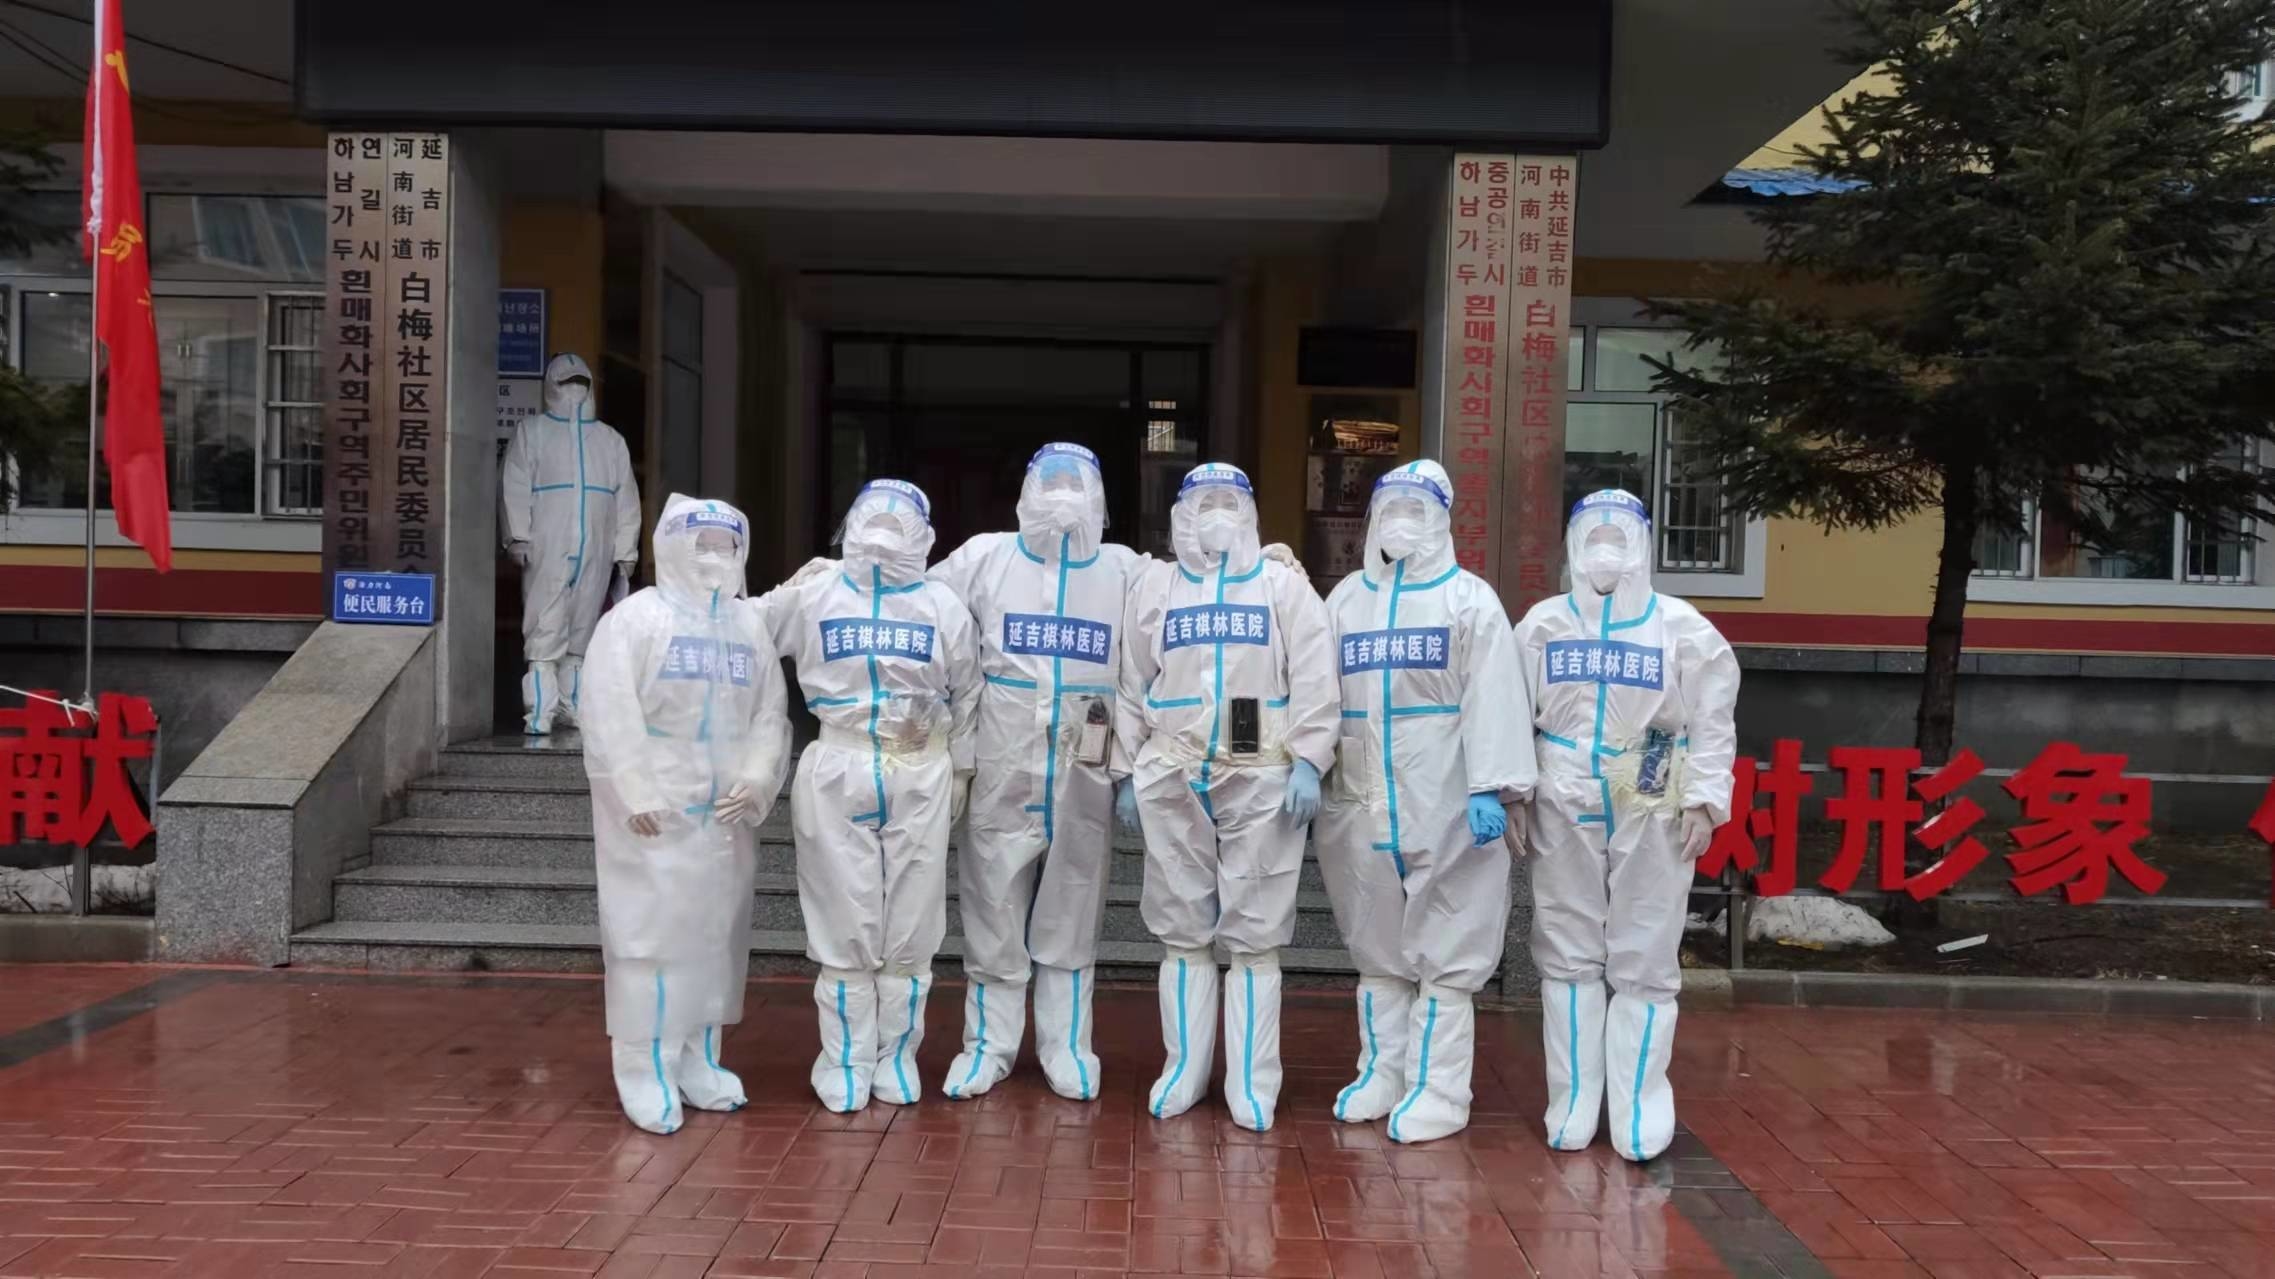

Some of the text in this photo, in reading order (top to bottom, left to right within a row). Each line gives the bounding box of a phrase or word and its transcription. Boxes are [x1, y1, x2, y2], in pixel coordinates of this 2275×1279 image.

[332, 137, 354, 261] 하남가두
[359, 137, 382, 262] 연길시
[392, 138, 414, 260] 河南街道
[420, 138, 443, 260] 延吉市
[1456, 161, 1481, 286] 하남가두
[1517, 164, 1542, 288] 河南街道
[1546, 164, 1570, 288] 中共延吉市
[395, 271, 433, 572] 白梅社区居民委员
[344, 593, 425, 615] 便民服务台
[826, 624, 928, 656] 延吉棋林医院
[1008, 621, 1107, 657] 延吉棋林医院
[1166, 611, 1264, 644] 延吉棋林医院
[1344, 634, 1443, 667] 延吉棋林医院
[1551, 647, 1660, 683] 延吉棋林医院
[0, 690, 158, 849] 献
